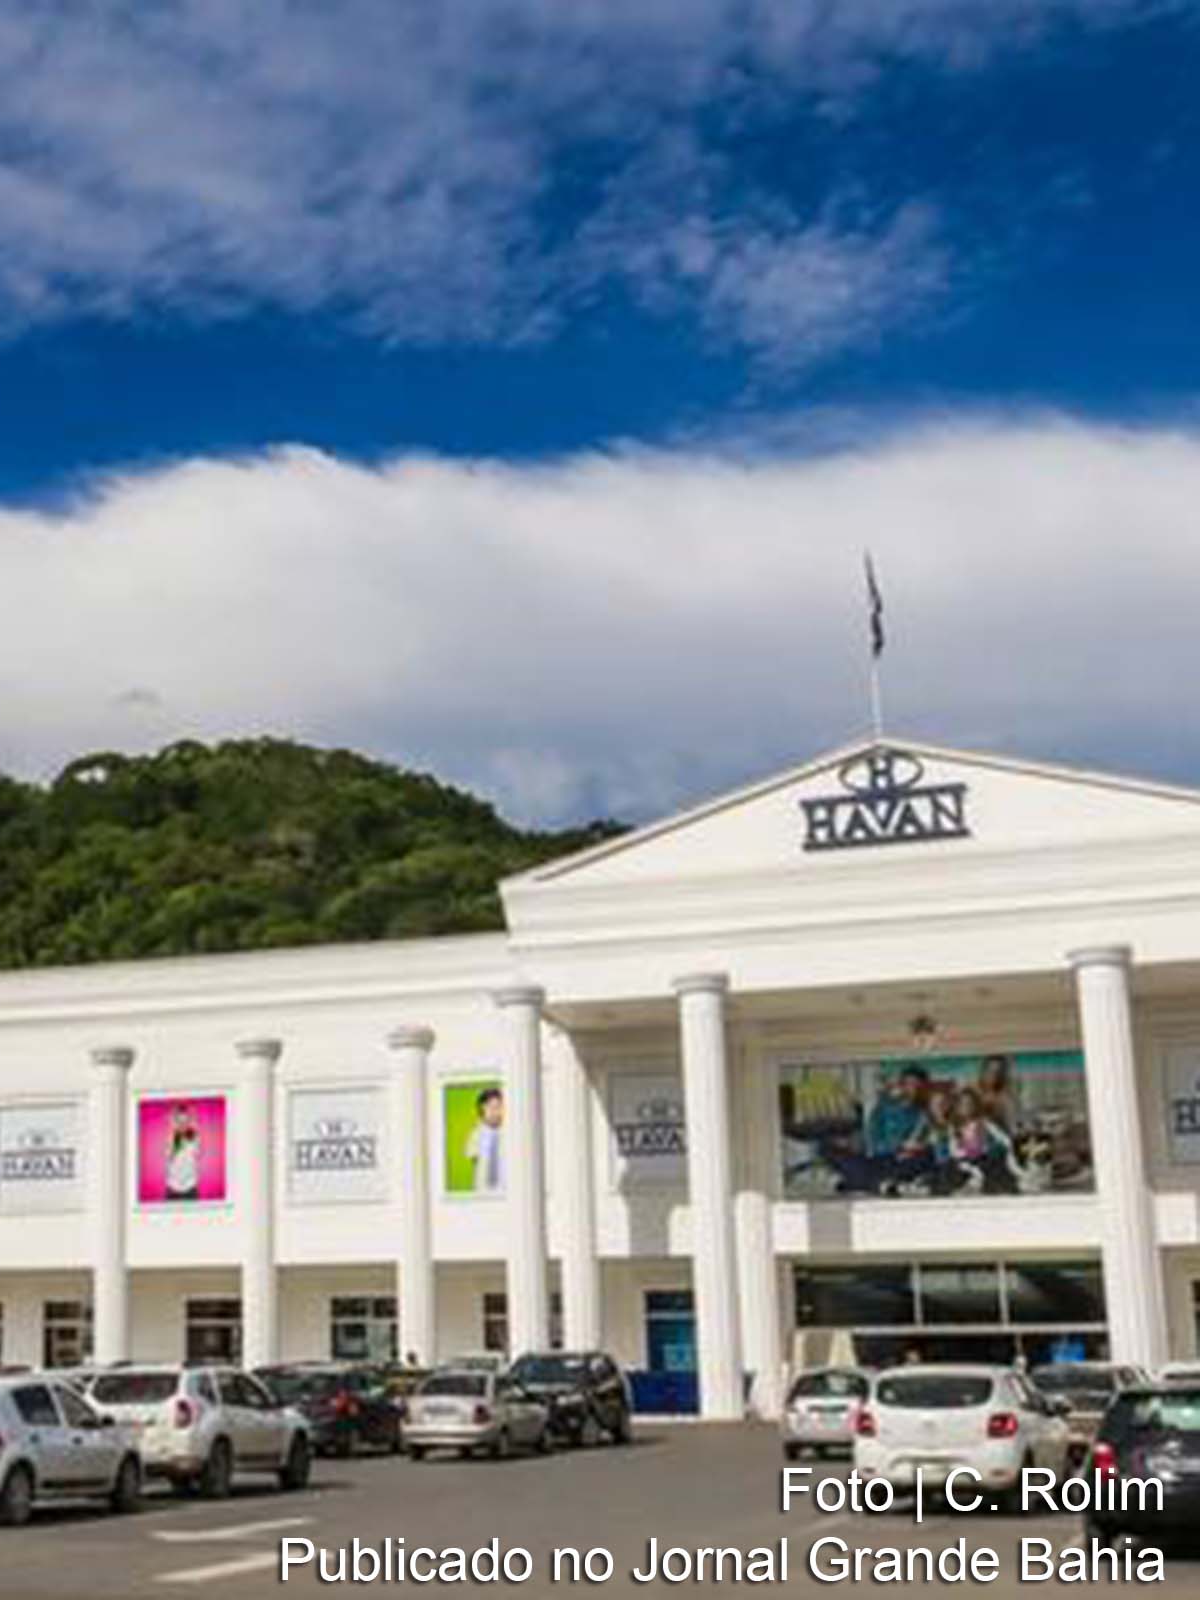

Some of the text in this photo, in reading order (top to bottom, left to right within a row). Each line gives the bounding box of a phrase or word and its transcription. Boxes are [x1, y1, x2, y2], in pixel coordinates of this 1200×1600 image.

[799, 782, 970, 852] HAVAN
[0, 1148, 75, 1180] HAVAN
[296, 1135, 377, 1170] HAVAN
